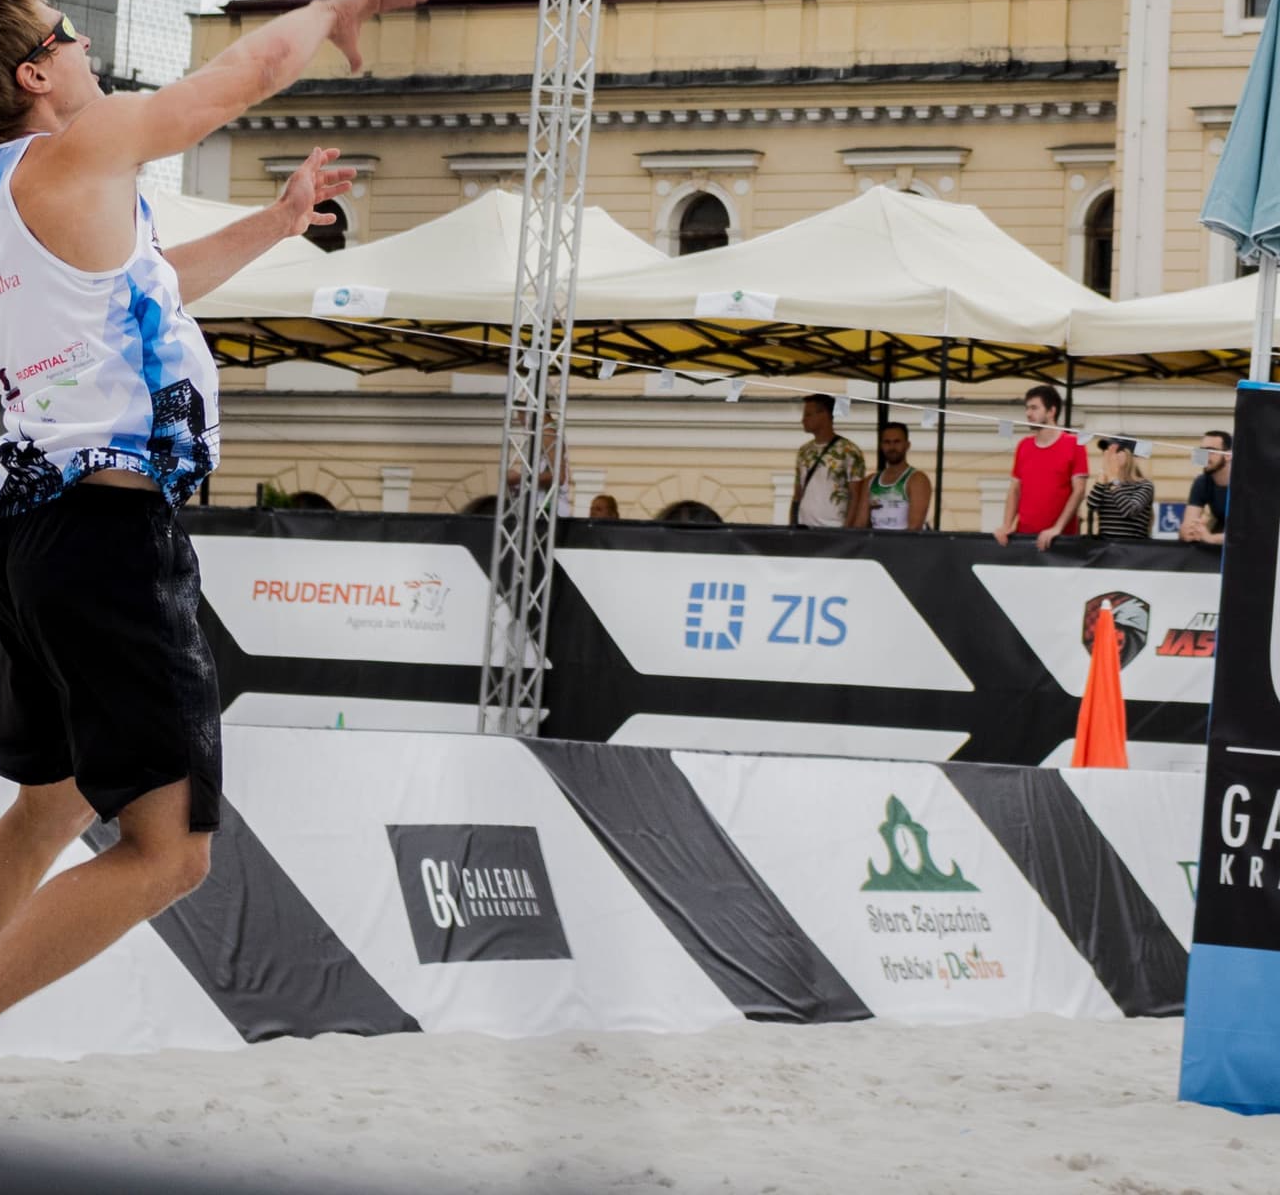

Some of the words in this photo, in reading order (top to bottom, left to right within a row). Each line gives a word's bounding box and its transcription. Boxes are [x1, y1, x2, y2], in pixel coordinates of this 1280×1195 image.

[252, 579, 401, 607] PRUDENTIAL
[767, 593, 849, 647] ZIS
[421, 857, 466, 929] GK
[461, 867, 537, 899] GALERIA
[866, 904, 912, 933] Stara
